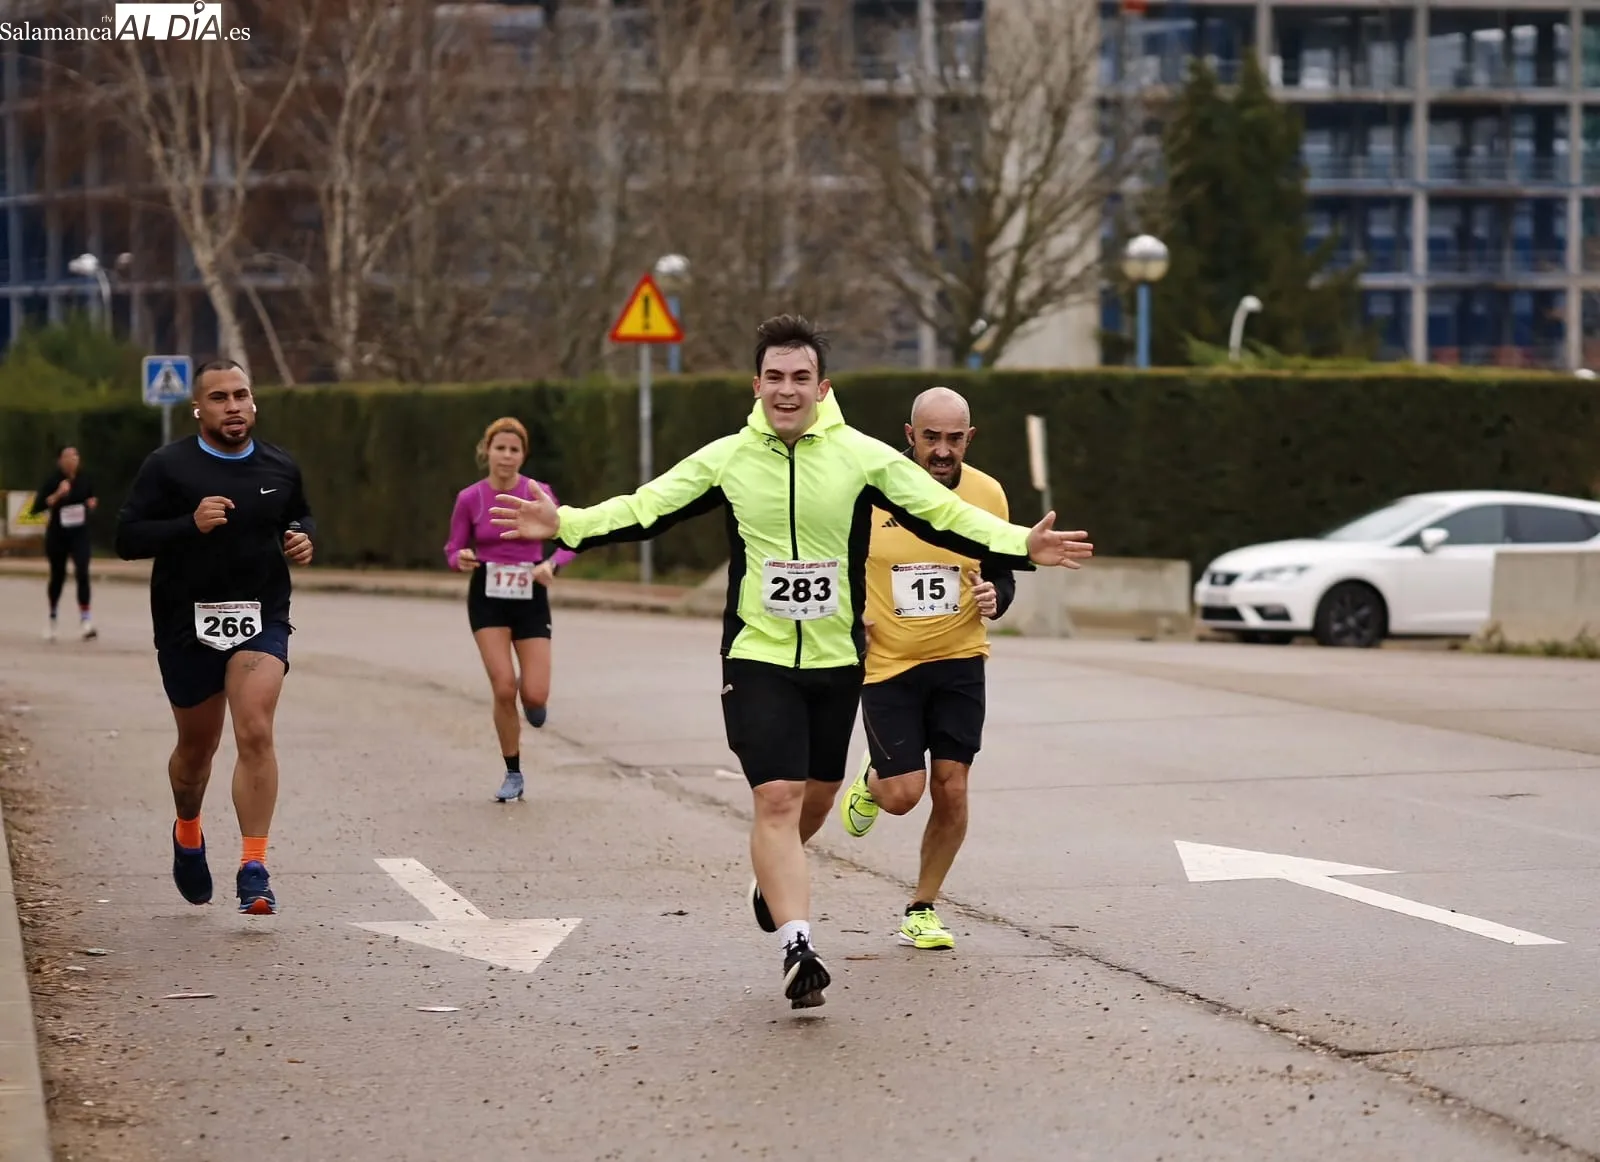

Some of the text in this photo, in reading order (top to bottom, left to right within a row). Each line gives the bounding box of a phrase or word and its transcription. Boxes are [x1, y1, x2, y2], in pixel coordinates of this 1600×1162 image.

[494, 571, 529, 588] 175
[769, 576, 832, 603] 283
[910, 577, 946, 601] 15
[203, 615, 257, 638] 266
